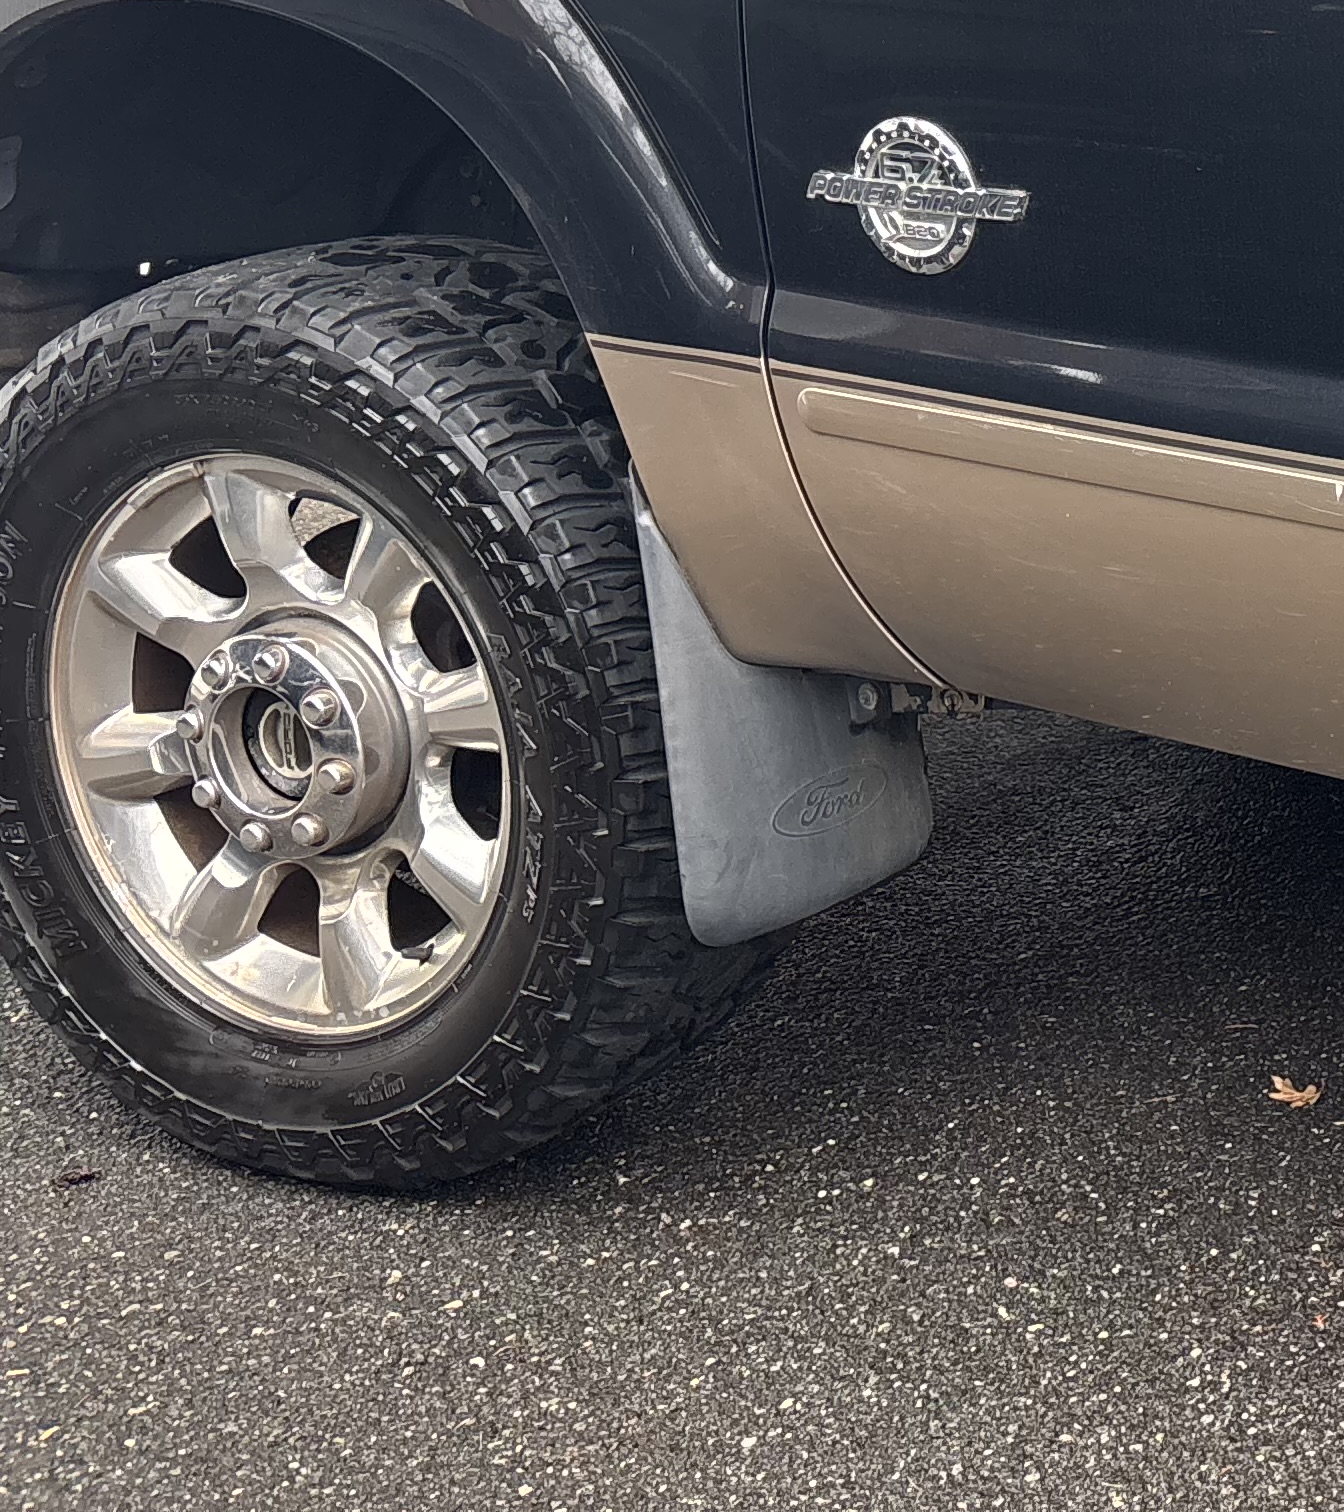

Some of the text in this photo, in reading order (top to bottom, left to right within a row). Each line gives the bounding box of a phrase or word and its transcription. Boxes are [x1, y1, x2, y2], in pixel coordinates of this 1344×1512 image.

[807, 171, 1027, 220] POWER STROKE
[800, 775, 865, 827] Ford
